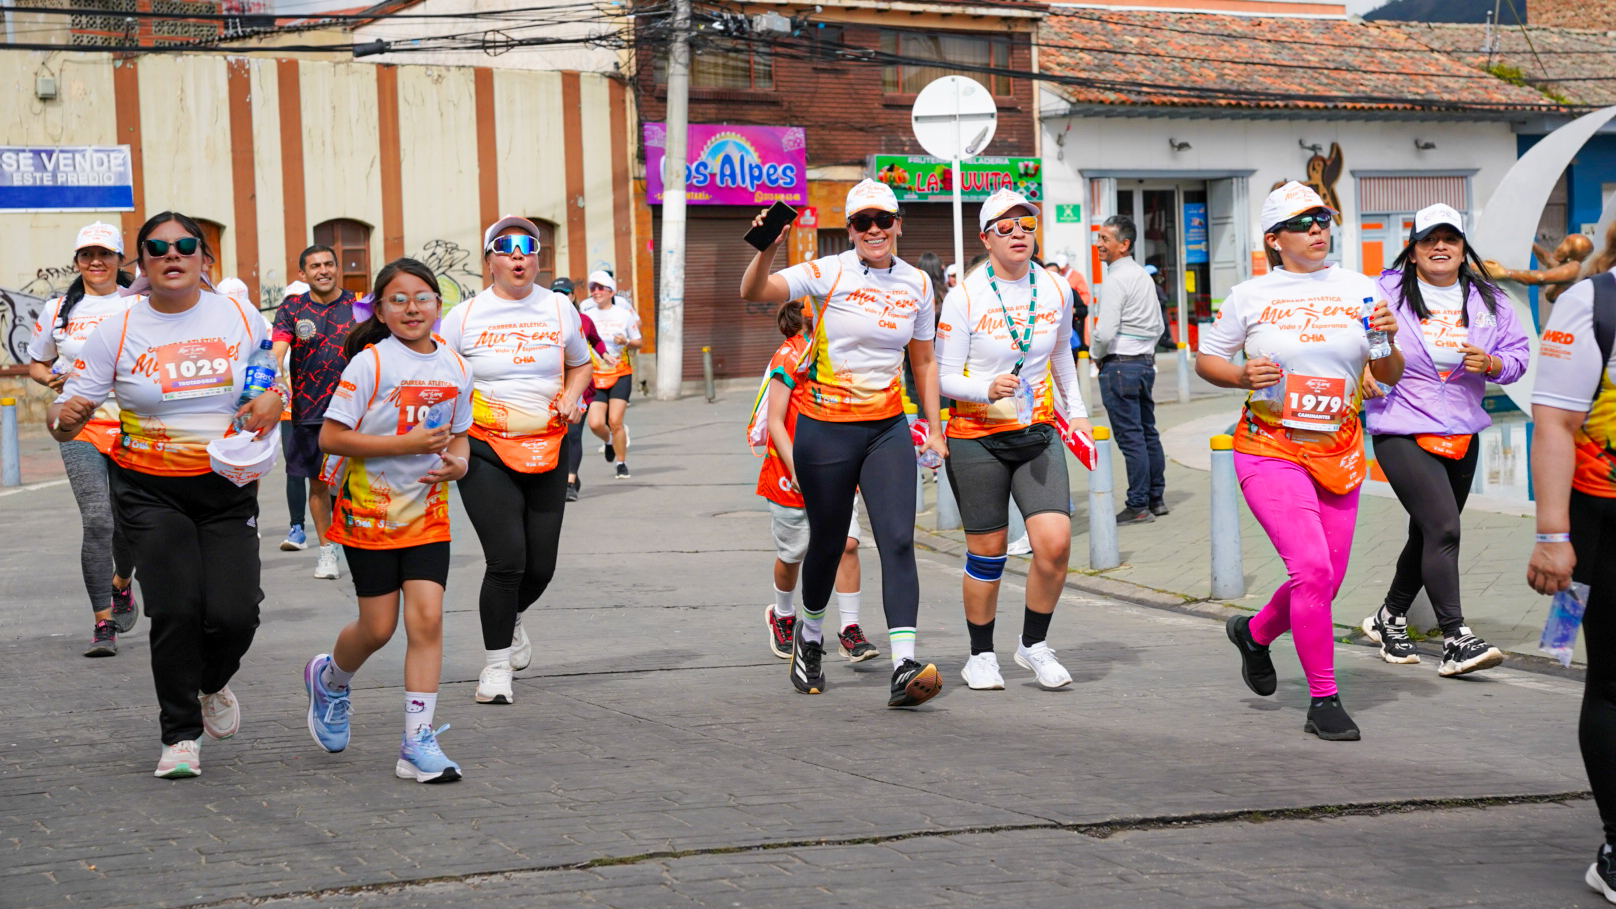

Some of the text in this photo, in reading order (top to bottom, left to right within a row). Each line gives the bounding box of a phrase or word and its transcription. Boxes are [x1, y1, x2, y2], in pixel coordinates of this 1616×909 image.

[1, 152, 125, 172] SE VENDE
[12, 172, 115, 185] ESTE PREDIO
[715, 153, 798, 192] Alpes
[916, 171, 1013, 193] LA UVITA
[165, 357, 229, 379] 1029
[178, 377, 218, 387] TROTADORAS
[1289, 392, 1342, 413] 1979
[1297, 412, 1331, 420] CAMINANTES
